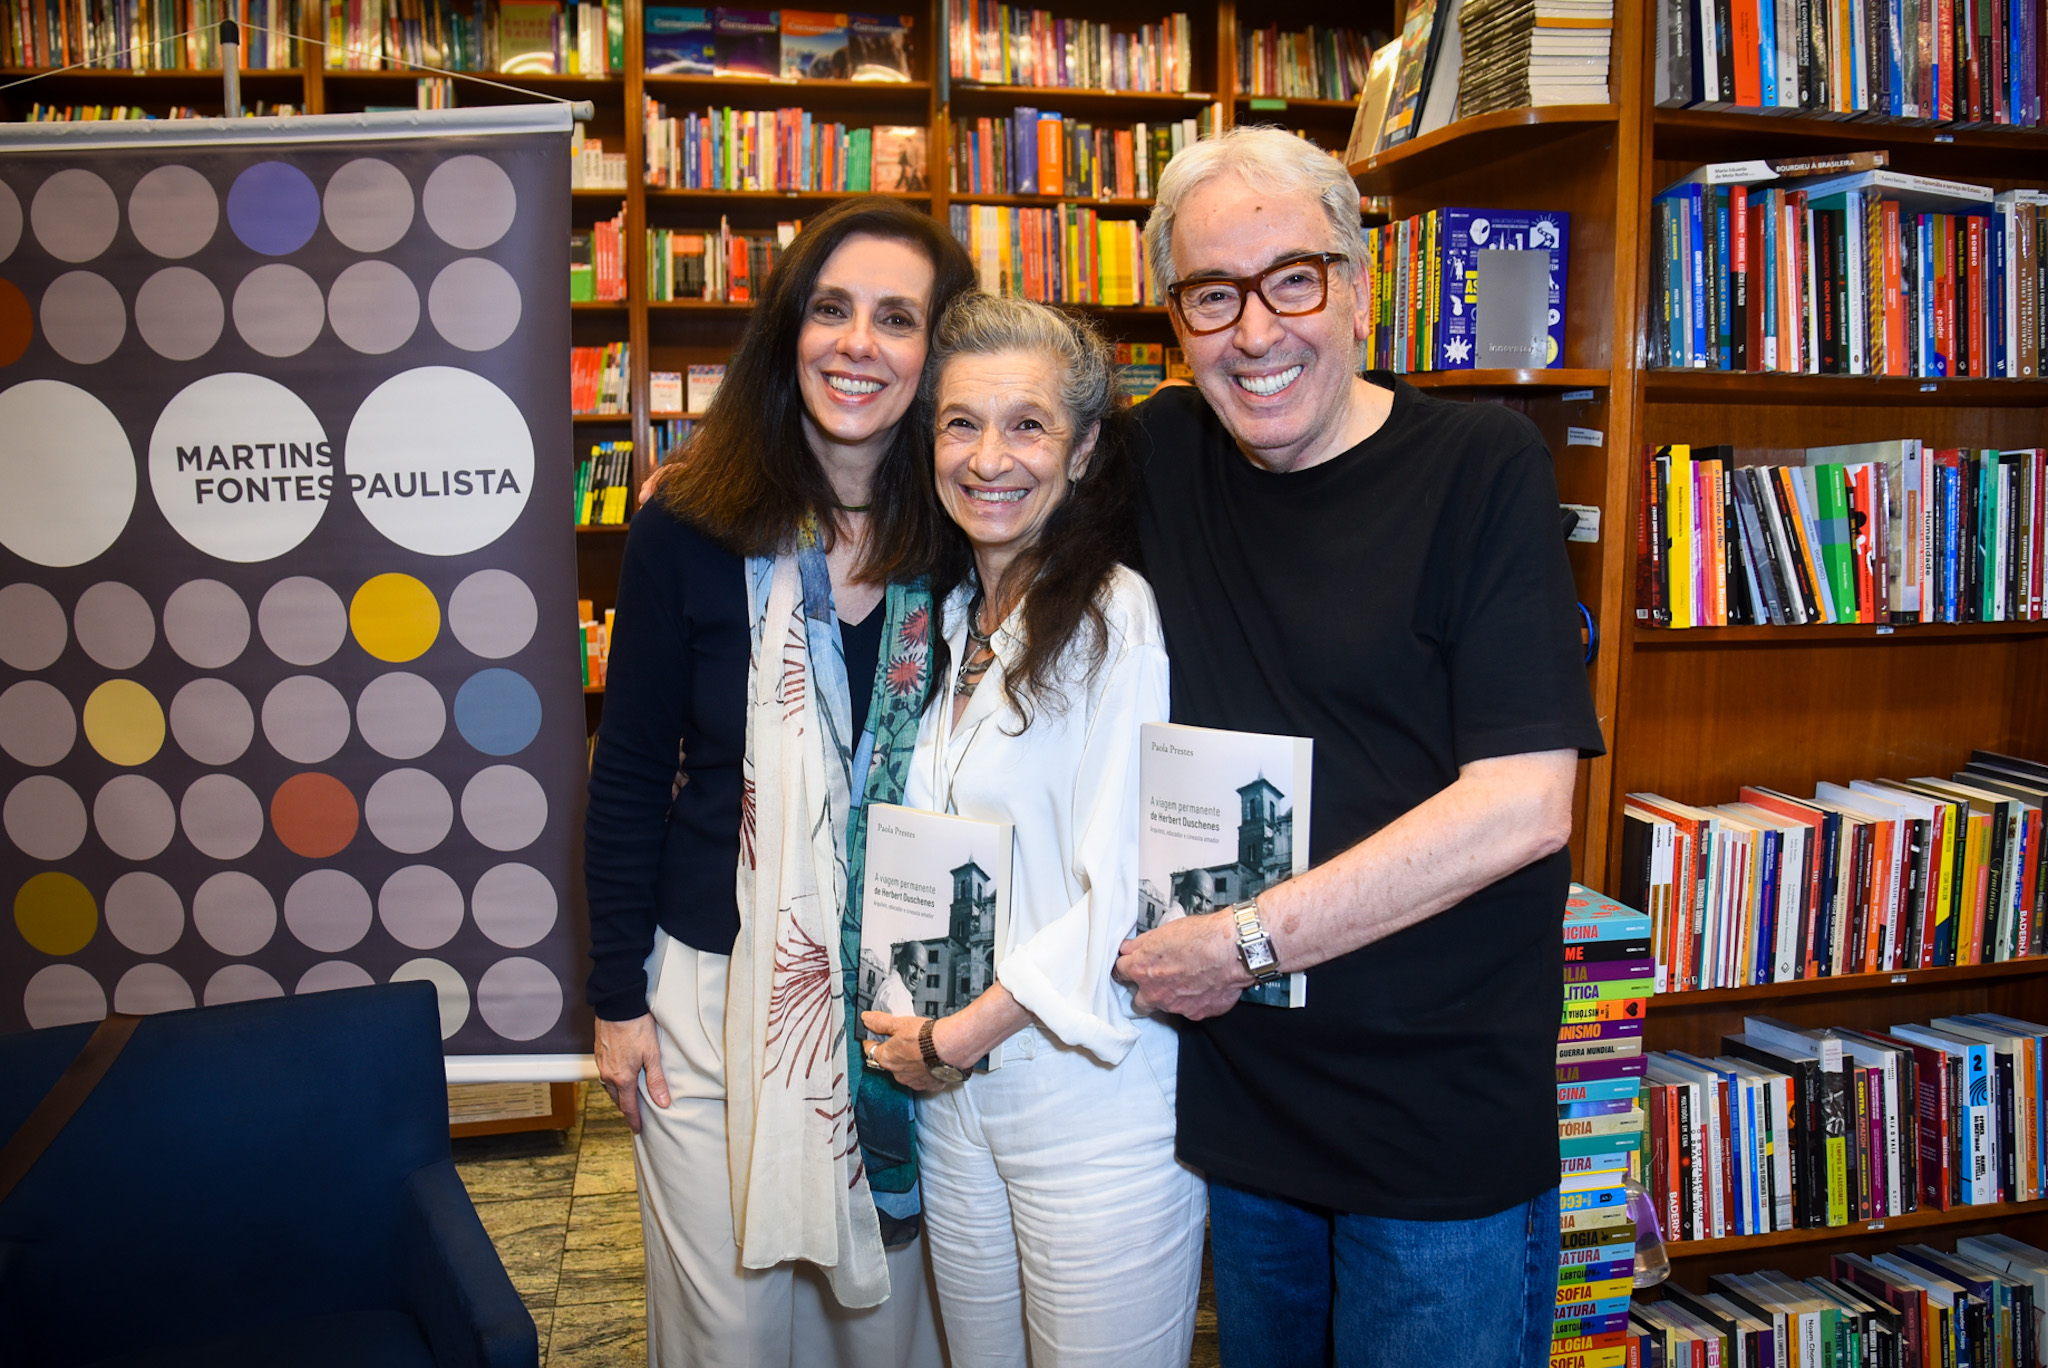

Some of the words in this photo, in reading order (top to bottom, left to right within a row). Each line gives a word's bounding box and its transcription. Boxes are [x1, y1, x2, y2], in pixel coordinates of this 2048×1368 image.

[1677, 25, 1682, 33] DO
[1776, 164, 1810, 173] BOURDIEU
[1818, 159, 1855, 168] BRASILEIRA
[1971, 223, 1977, 232] N.
[1695, 251, 1703, 286] LIBERALISMO
[2022, 268, 2026, 277] NA
[1825, 303, 1830, 312] DE
[1936, 316, 1945, 339] poder
[176, 441, 332, 471] MARTINS
[195, 475, 333, 504] FONTES
[346, 468, 521, 499] PAULISTA
[1715, 477, 1723, 514] feiticeiro
[1717, 516, 1723, 525] da
[1814, 549, 1822, 562] DITAS
[1718, 562, 1726, 586] Atilio
[1817, 563, 1826, 580] COISAS
[1152, 742, 1168, 753] Paola
[1170, 745, 1194, 757] Prestes
[1151, 796, 1154, 805] A
[1155, 799, 1177, 812] viagem
[1179, 803, 1221, 817] permanente
[1150, 811, 1157, 821] de
[1158, 813, 1181, 826] Herbert
[1183, 818, 1220, 831] Duschenes
[877, 823, 893, 834] Paola
[895, 827, 915, 839] Prestes
[874, 873, 879, 881] A
[880, 876, 899, 887] viagem
[900, 880, 936, 895] permanente
[1892, 859, 1900, 902] LIBERDADE,
[874, 887, 881, 896] de
[882, 888, 902, 902] Herbert
[903, 893, 935, 907] Duschenes
[2018, 910, 2028, 957] BADERNA
[1569, 1008, 1599, 1020] HISTÓRIA
[1560, 1049, 1585, 1058] GUERRA
[1587, 1046, 1615, 1055] MUNDIAL
[1973, 1054, 1982, 1072] 2
[1710, 1080, 1718, 1098] FHC
[1680, 1096, 1688, 1123] MULTIDÕES
[1859, 1117, 1867, 1148] AMAZON
[2030, 1120, 2036, 1129] DO
[1681, 1134, 1689, 1147] CENA
[1697, 1150, 1702, 1159] DE
[1758, 1155, 1766, 1169] POLÍTICA
[1669, 1191, 1680, 1241] BADERNA
[1560, 1269, 1600, 1280] LGBTQIAPN+
[1557, 1286, 1592, 1302] SOFIA
[1551, 1336, 1593, 1354] OLOGIA
